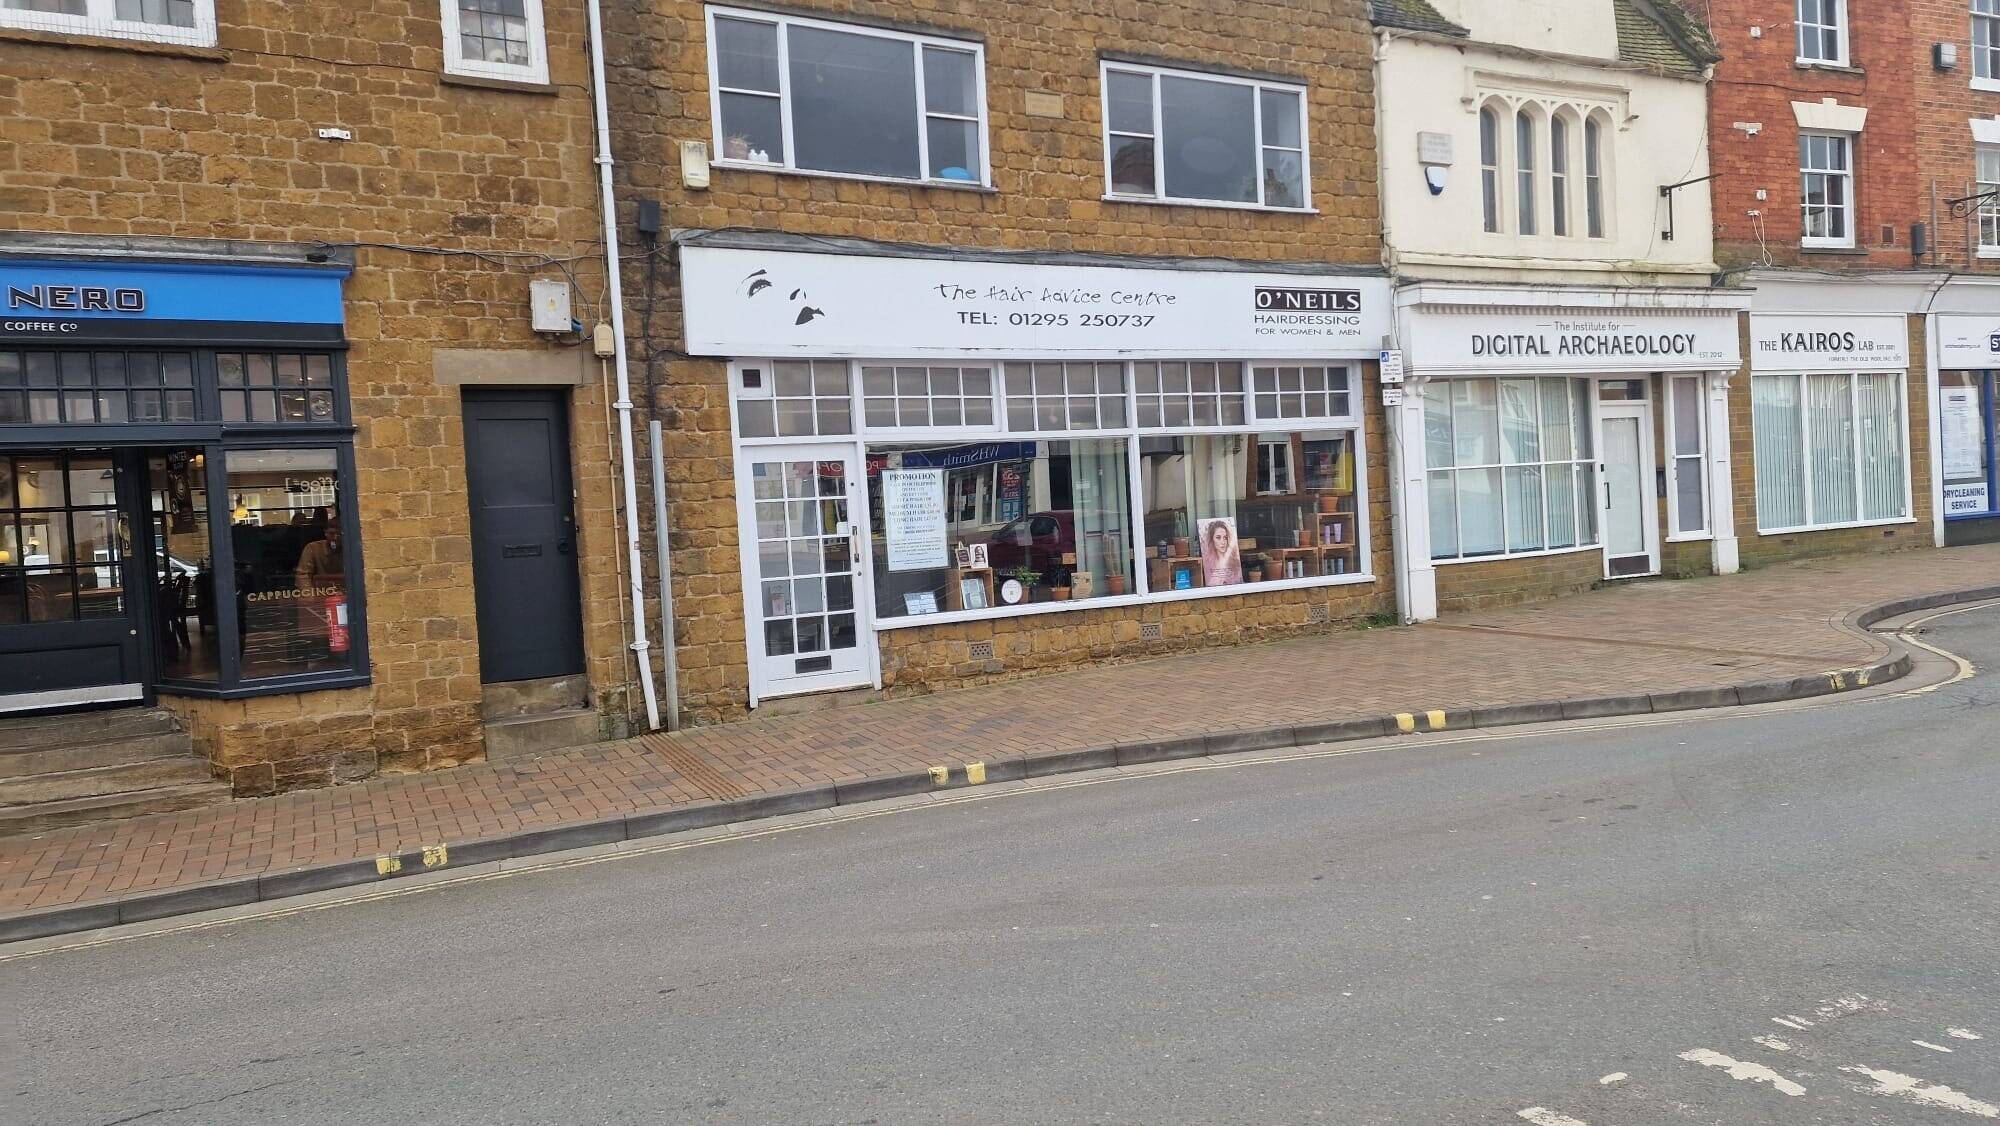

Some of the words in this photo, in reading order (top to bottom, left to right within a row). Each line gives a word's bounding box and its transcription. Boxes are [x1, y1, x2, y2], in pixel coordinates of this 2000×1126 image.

[7, 285, 145, 311] NERO
[933, 284, 977, 301] The
[984, 285, 1032, 302] Hair
[1040, 287, 1102, 304] Advice
[1110, 290, 1177, 306] Centre
[1256, 291, 1360, 310] O'NEILS
[4, 321, 56, 332] COFFEE
[957, 311, 998, 326] TEL:
[1008, 312, 1069, 327] 01295
[1079, 313, 1155, 328] 250737
[1254, 314, 1360, 326] HAIRDRESSING
[1554, 321, 1570, 331] The
[1573, 321, 1606, 332] Institute
[1608, 321, 1620, 332] for
[1255, 327, 1276, 335] FOR
[1326, 328, 1334, 336] &
[1471, 334, 1551, 356] DIGITAL
[1558, 333, 1696, 356] ARCHAEOLOGY
[1759, 340, 1777, 351] THE
[1780, 331, 1855, 352] KAIROS
[1858, 340, 1874, 351] LAB
[889, 472, 936, 481] PROMOTION
[1951, 499, 1977, 510] SERVICE
[246, 586, 338, 602] CAPPUCCINO
